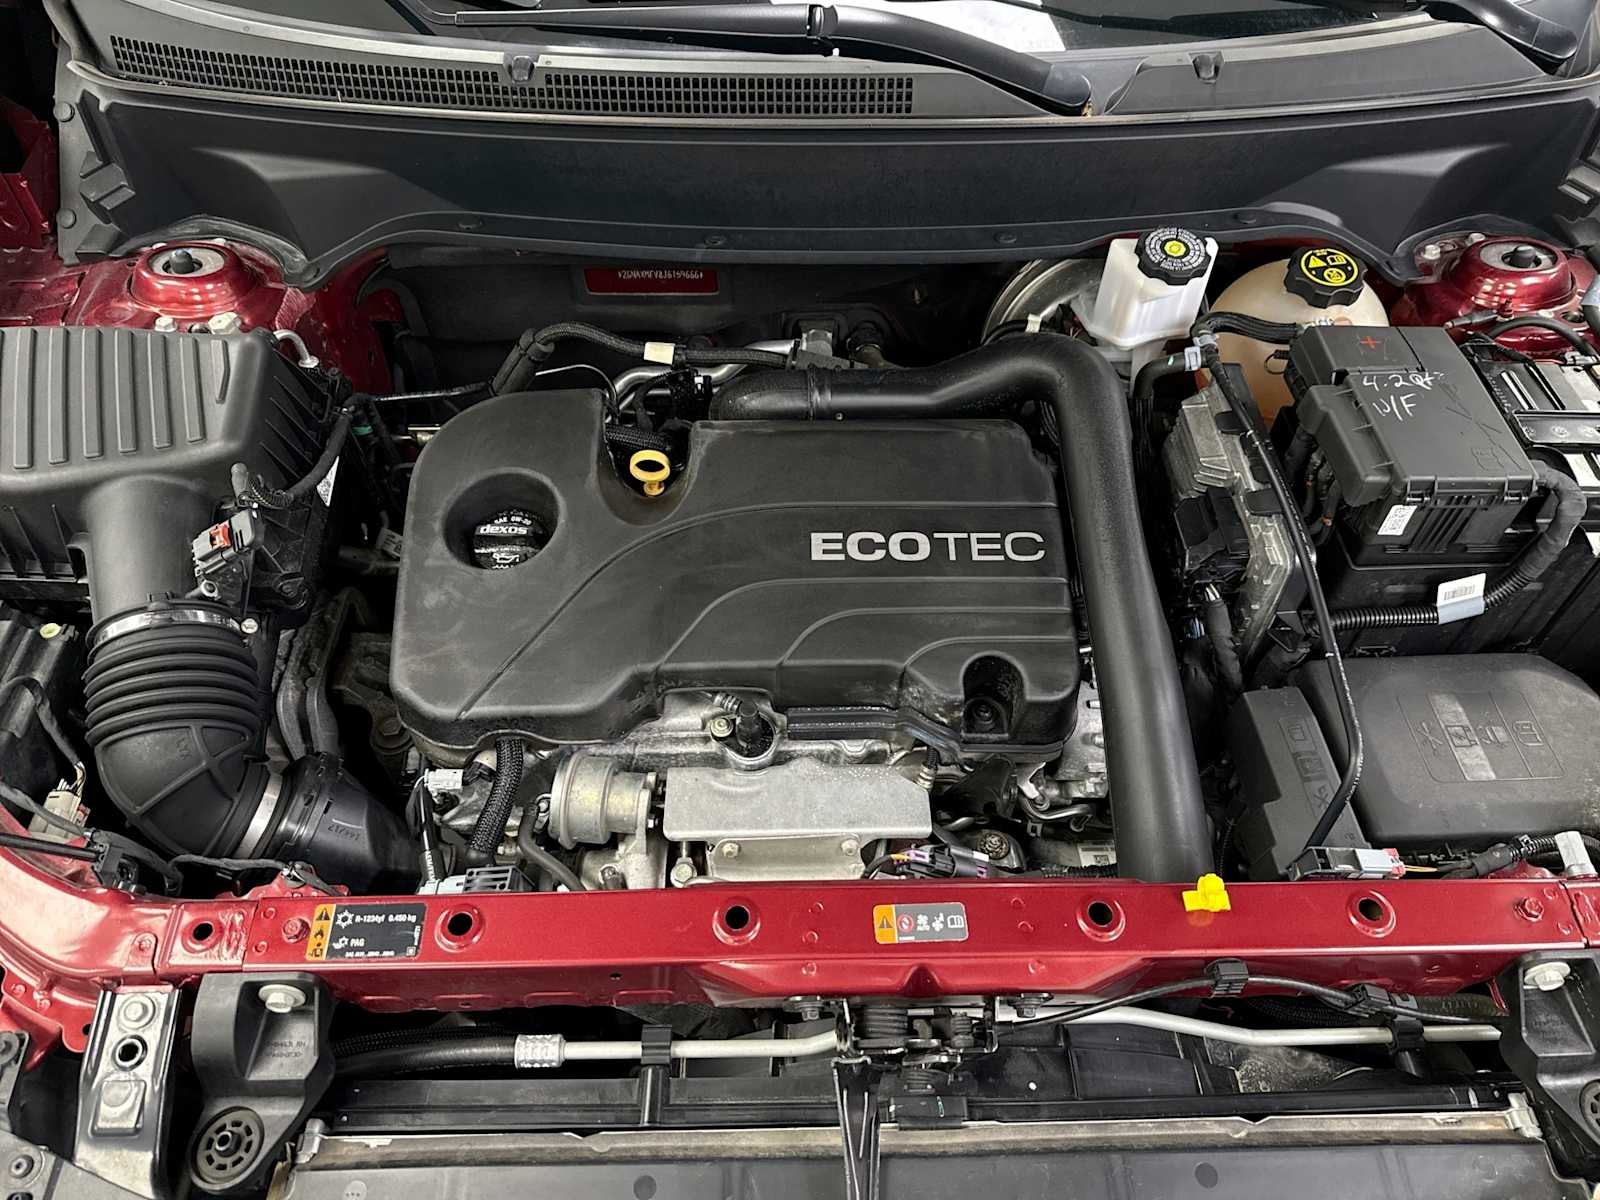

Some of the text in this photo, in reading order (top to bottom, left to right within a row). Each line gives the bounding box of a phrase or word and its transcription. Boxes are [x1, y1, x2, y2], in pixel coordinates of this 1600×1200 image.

[480, 524, 528, 535] dexos
[810, 531, 1046, 562] ECOTEC
[350, 938, 365, 947] PAG
